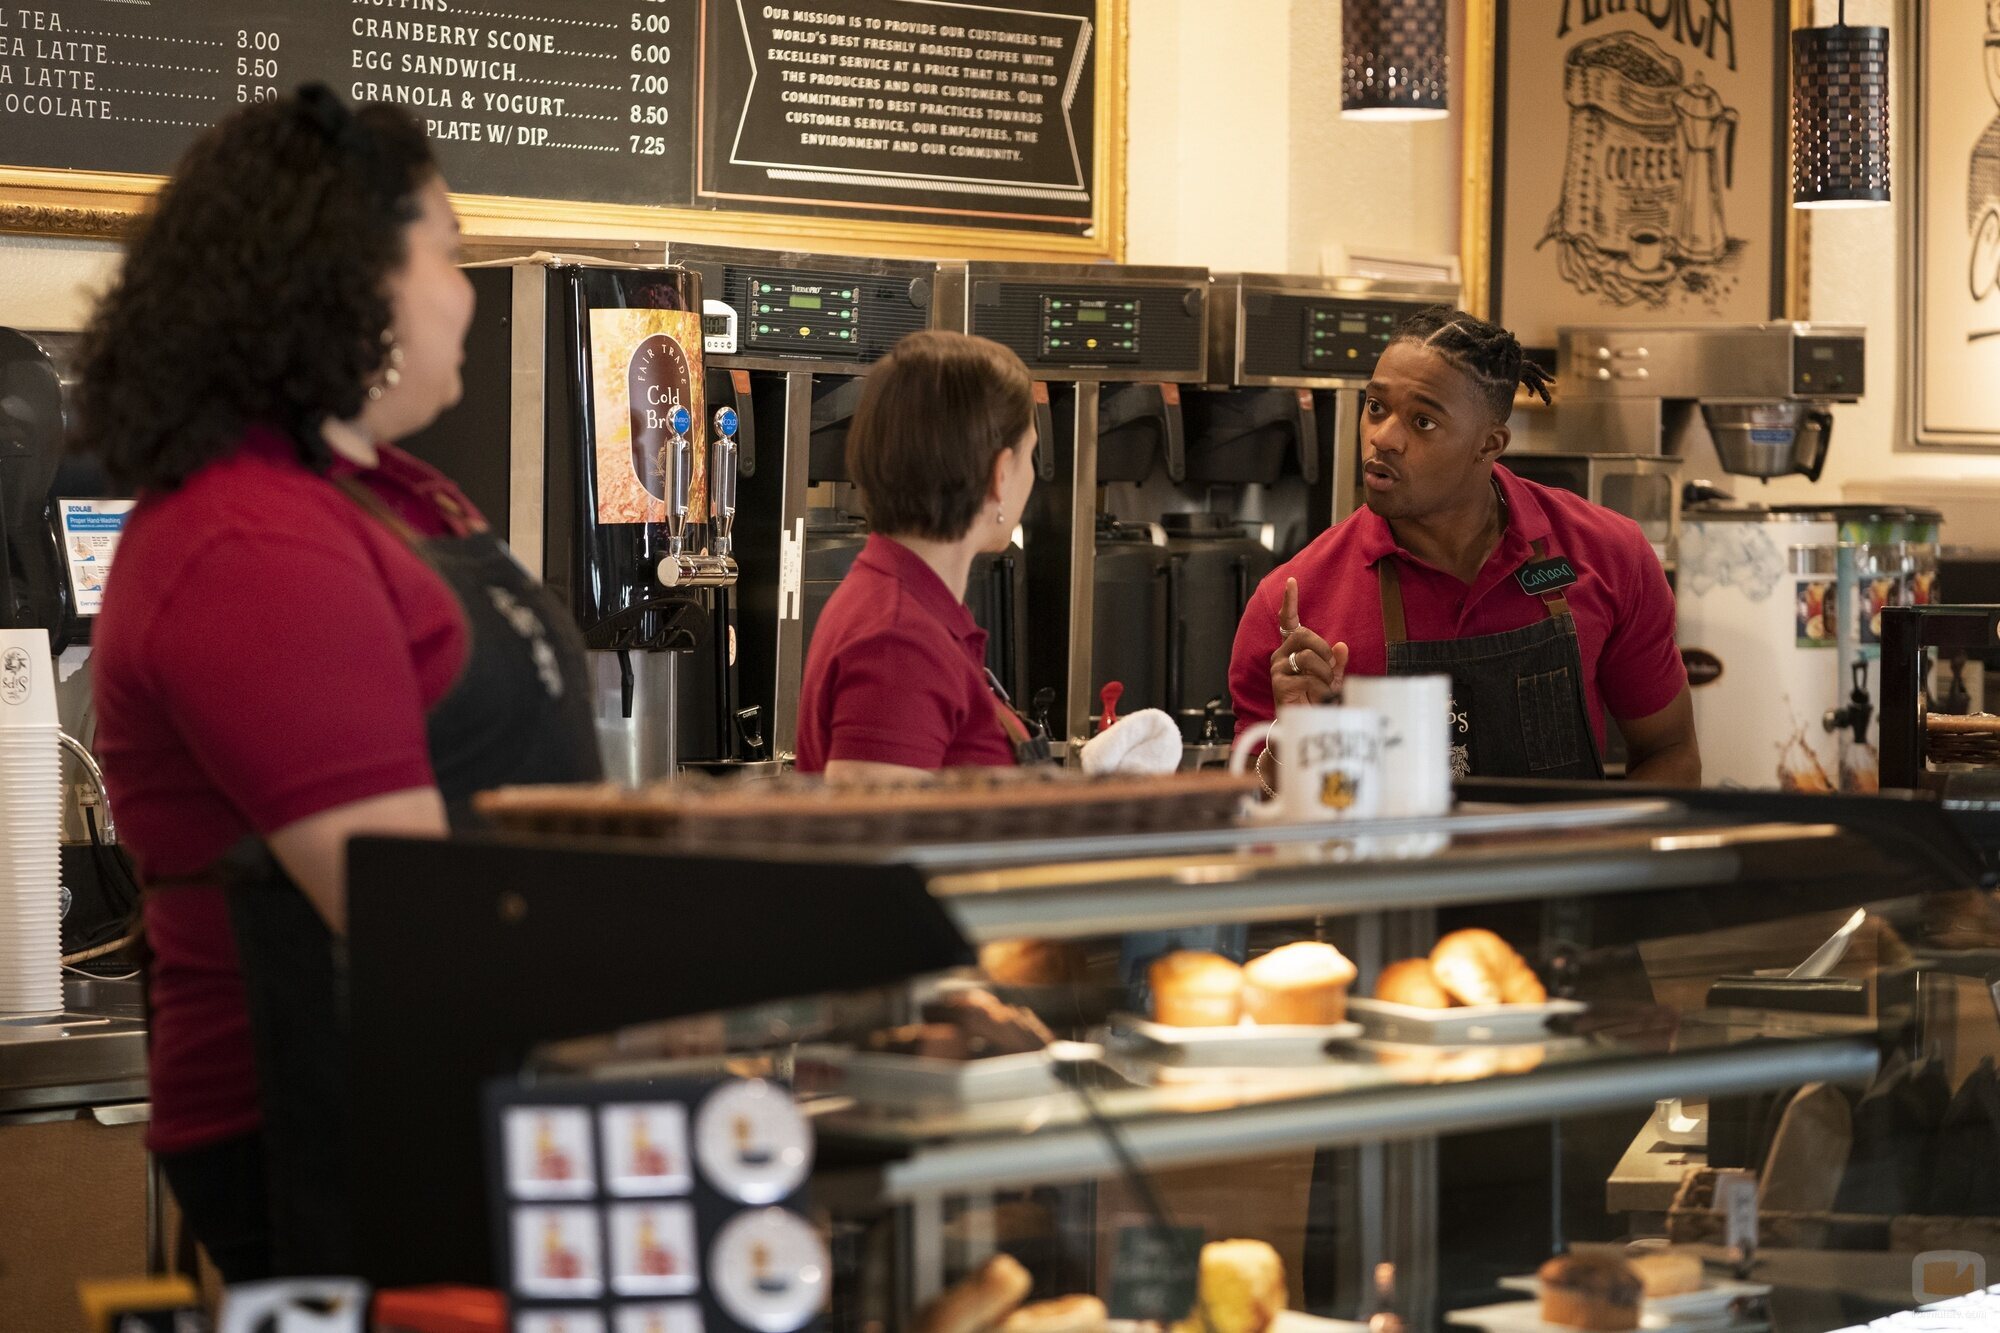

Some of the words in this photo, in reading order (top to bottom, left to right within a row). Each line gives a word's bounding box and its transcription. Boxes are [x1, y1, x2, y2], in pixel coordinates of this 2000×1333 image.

[18, 10, 62, 32] TEA
[237, 30, 280, 51] 3.00
[352, 17, 480, 46] CRANBERRY
[487, 30, 555, 54] SCONE
[630, 43, 670, 64] 6.00
[630, 13, 670, 34] 5.00
[793, 10, 846, 26] MISSION
[849, 16, 862, 28] IS
[865, 18, 881, 30] TO
[884, 20, 937, 35] PROVIDE
[939, 26, 965, 38] OUR
[967, 28, 1037, 46] CUSTOMERS
[1039, 36, 1064, 48] THE
[37, 39, 108, 64] LATTE
[237, 57, 278, 78] 5.50
[772, 28, 827, 45] WORLD'S
[830, 34, 860, 48] BEST
[863, 38, 916, 54] FRESHLY
[919, 43, 973, 59] ROASTED
[975, 49, 1020, 64] COFFEE
[1022, 53, 1054, 67] WITH
[24, 66, 96, 91] LATTE
[236, 84, 278, 103] 5.50
[352, 49, 393, 71] EGG
[401, 54, 516, 82] SANDWICH
[629, 74, 669, 95] 7.00
[767, 49, 837, 66] EXCELLENT
[839, 56, 890, 71] SERVICE
[893, 60, 909, 73] AT
[912, 62, 921, 74] A
[924, 63, 960, 78] PRICE
[962, 67, 994, 80] THAT
[996, 70, 1009, 82] IS
[1011, 72, 1039, 85] FAIR
[1041, 75, 1058, 87] TO
[781, 70, 806, 83] THE
[809, 73, 881, 90] PRODUCERS
[884, 80, 910, 92] AND
[912, 82, 938, 95] OUR
[0, 92, 112, 120] OCOLATE
[352, 81, 453, 108] GRANOLA
[461, 91, 476, 110] &
[483, 92, 565, 117] YOGURT
[629, 104, 669, 125] 8.50
[781, 91, 865, 109] COMMITMENT
[867, 98, 884, 110] TO
[886, 99, 917, 113] BEST
[919, 103, 984, 119] PRACTICES
[986, 108, 1043, 124] TOWARDS
[426, 119, 482, 142] PLATE
[487, 123, 513, 146] W/
[517, 126, 549, 146] DIP
[629, 135, 666, 156] 7.25
[785, 111, 851, 127] CUSTOMER
[911, 122, 938, 135] OUR
[1015, 130, 1039, 144] THE
[800, 132, 890, 150] ENVIRONMENT
[892, 140, 918, 153] AND
[920, 142, 946, 155] OUR
[638, 348, 655, 383] FAIR
[661, 344, 687, 384] TRADE
[647, 384, 680, 405] Cold
[646, 409, 666, 429] Br
[68, 505, 92, 513] ECOLAB
